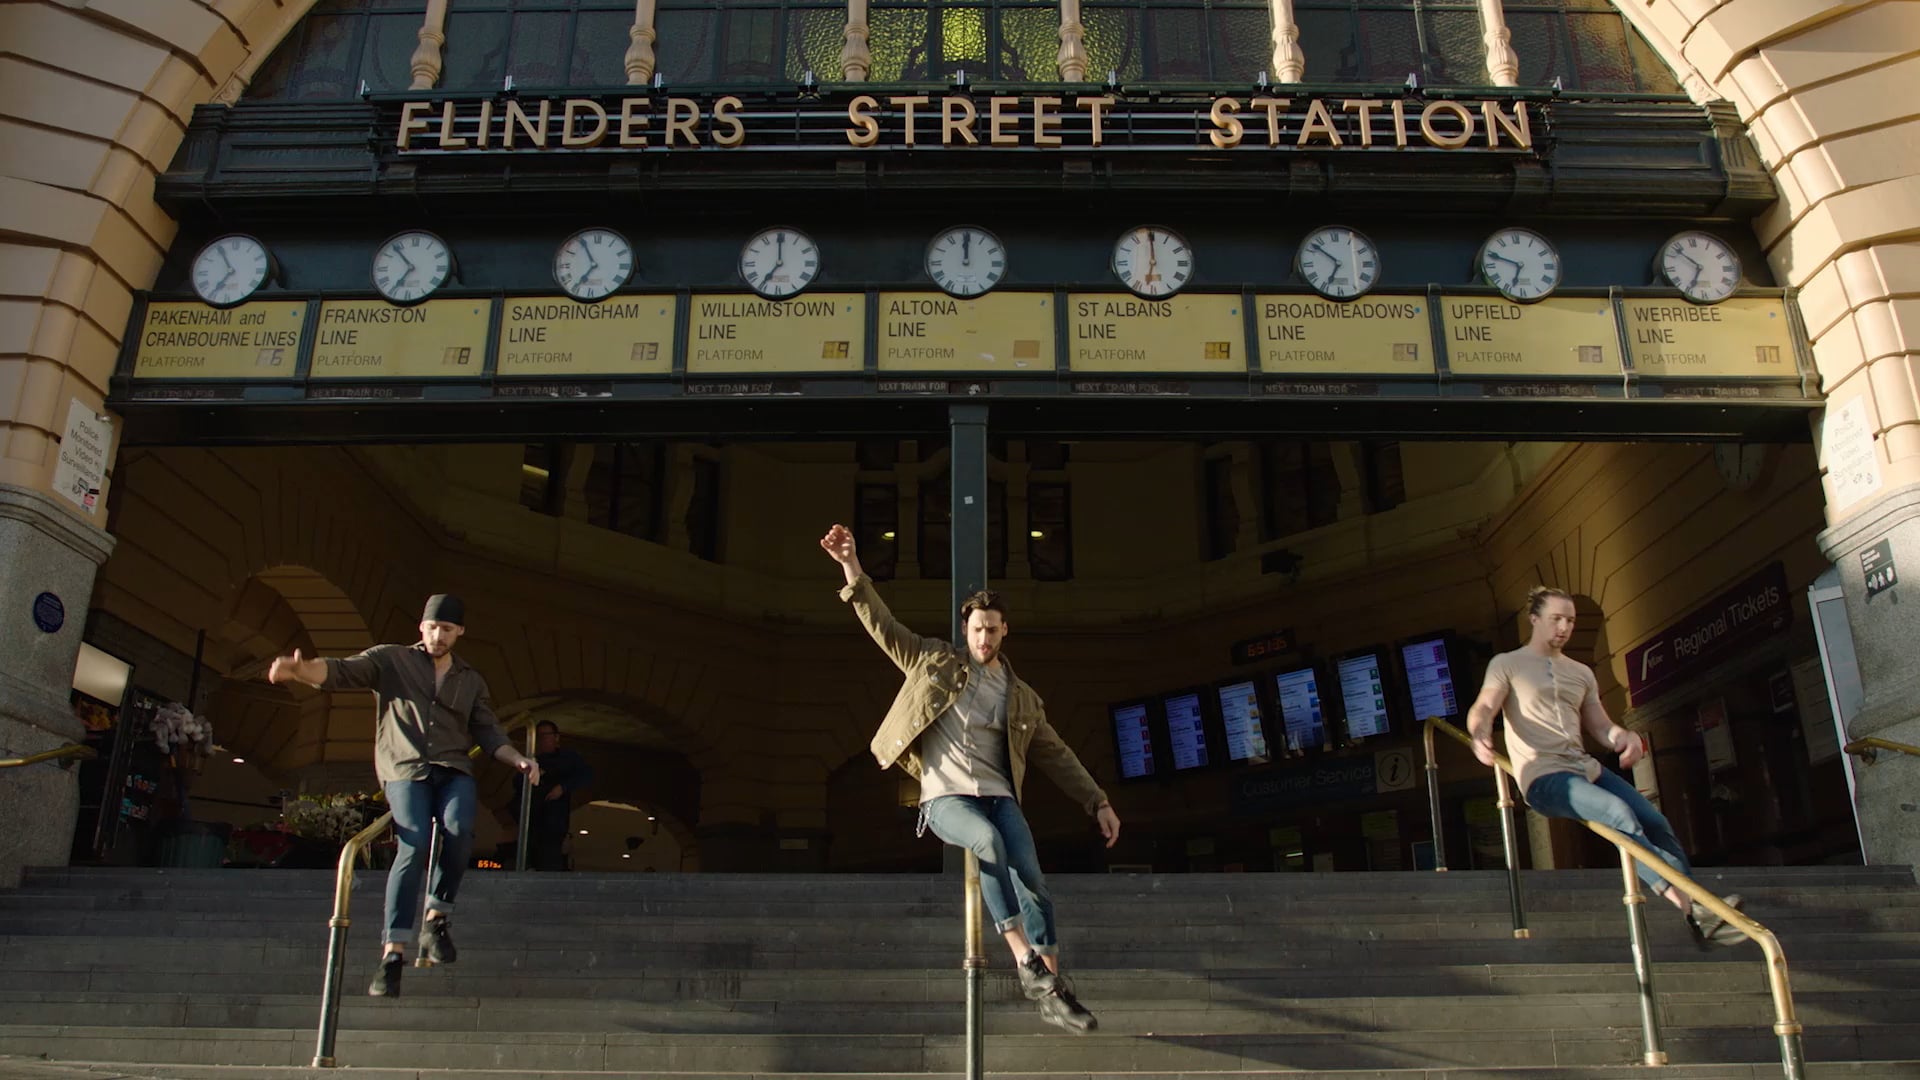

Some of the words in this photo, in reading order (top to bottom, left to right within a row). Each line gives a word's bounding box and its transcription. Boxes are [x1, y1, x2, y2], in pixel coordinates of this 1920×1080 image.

[397, 96, 744, 150] FLINDERS
[846, 95, 1115, 149] STREET
[1209, 97, 1532, 152] STATION
[512, 304, 640, 321] SANDRINGHAM
[702, 302, 835, 318] WILLIAMSTOWN
[889, 300, 958, 315] ALTONA
[1078, 302, 1099, 317] ST
[1104, 302, 1172, 317] ALBANS
[1265, 303, 1415, 319] BROADMEADOWS
[1452, 304, 1521, 320] UPFIELD
[1633, 307, 1722, 322] WERRIBEE
[150, 310, 232, 325] PAKENHAM
[239, 311, 266, 325] and
[324, 308, 427, 323] FRANKSTON
[509, 327, 547, 342] LINE
[698, 324, 737, 339] LINE
[888, 322, 926, 337] LINE
[1078, 324, 1117, 339] LINE
[1268, 325, 1306, 340] LINE
[1454, 326, 1493, 341] LINE
[1637, 328, 1676, 344] LINE
[145, 331, 251, 347] CRANBOURNE
[253, 331, 298, 346] LINES
[320, 330, 358, 345] LINE
[507, 352, 573, 363] PLATFORM
[697, 350, 764, 361] PLATFORM
[888, 347, 955, 359] PLATFORM
[1080, 349, 1146, 361] PLATFORM
[1270, 350, 1335, 361] PLATFORM
[1457, 351, 1523, 363] PLATFORM
[1642, 353, 1707, 365] PLATFORM
[141, 356, 205, 368] PLATFORM
[317, 355, 382, 367] PLATFORM
[342, 388, 371, 397] TRAIN
[374, 387, 393, 397] FOR
[499, 386, 525, 396] NEXT
[528, 385, 559, 395] TRAIN
[688, 384, 714, 394] NEXT
[718, 383, 748, 393] TRAIN
[752, 383, 772, 393] FOR
[900, 382, 928, 391] TRAIN
[929, 381, 947, 391] FOR
[1075, 383, 1101, 393] NEXT
[1103, 383, 1136, 393] TRAIN
[1138, 383, 1159, 393] FOR
[1265, 384, 1291, 393] NEXT
[1294, 384, 1326, 394] TRAIN
[1329, 384, 1349, 394] FOR
[1497, 386, 1524, 395] NEXT
[80, 421, 99, 441] Police
[1673, 611, 1728, 660] Regional
[1727, 585, 1780, 627] Tickets
[1242, 775, 1313, 797] Customer
[1314, 764, 1372, 785] Service
